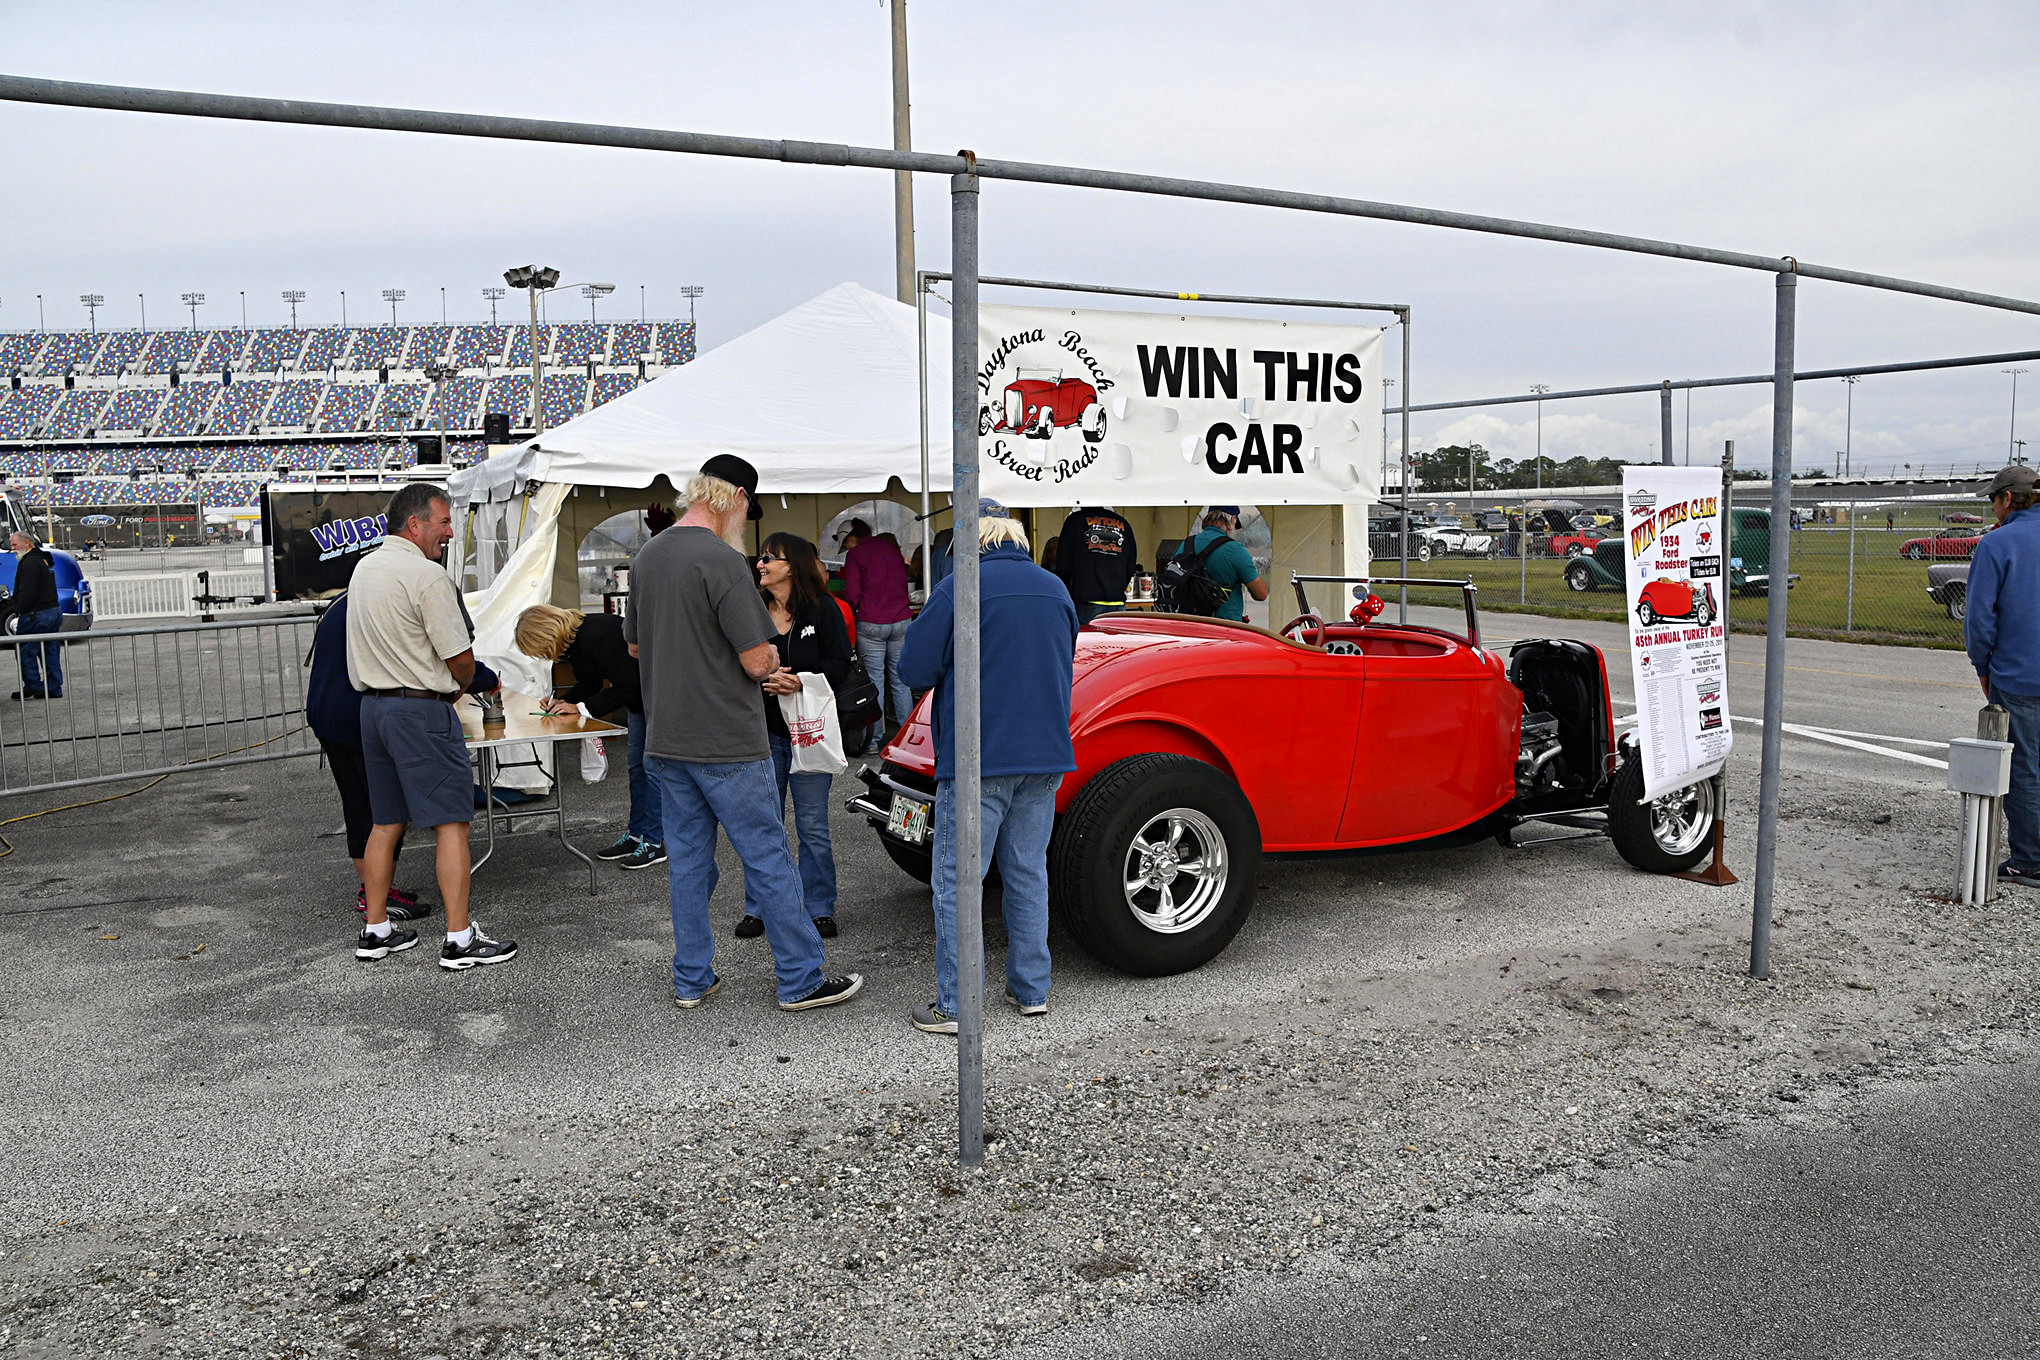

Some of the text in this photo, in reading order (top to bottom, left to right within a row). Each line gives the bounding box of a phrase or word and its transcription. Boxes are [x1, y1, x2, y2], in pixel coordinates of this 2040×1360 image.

[978, 328, 1115, 396] Daytona Beach
[1137, 345, 1362, 404] WIN THIS
[1205, 422, 1304, 475] CAR
[987, 440, 1098, 483] Street Rods
[86, 515, 109, 526] Ford
[1086, 517, 1124, 531] DAYTONA
[1631, 514, 1656, 560] WIN
[1658, 501, 1688, 534] THIS
[1690, 496, 1717, 520] CAR!
[1660, 535, 1679, 547] 1934
[1662, 548, 1678, 558] Ford
[1655, 560, 1688, 570] Roadster
[1635, 625, 1723, 647] 45th ANNUAL TURKEY RUN
